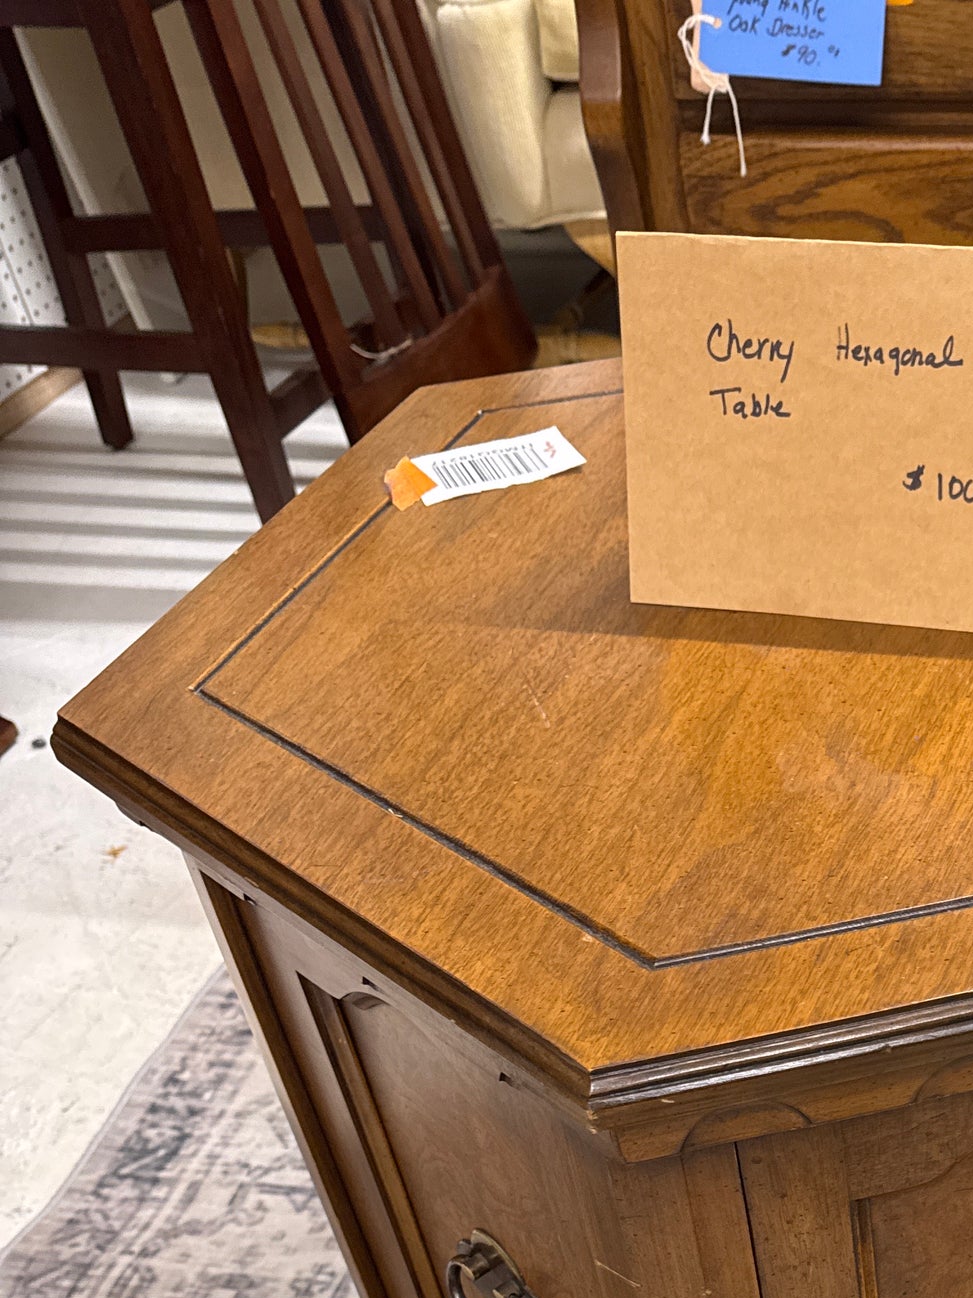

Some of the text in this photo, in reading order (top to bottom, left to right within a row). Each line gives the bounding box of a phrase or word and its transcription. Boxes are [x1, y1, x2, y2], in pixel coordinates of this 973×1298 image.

[767, 17, 824, 39] Dresser
[707, 318, 963, 383] Cherry Hexagonal
[709, 386, 791, 419] Table
